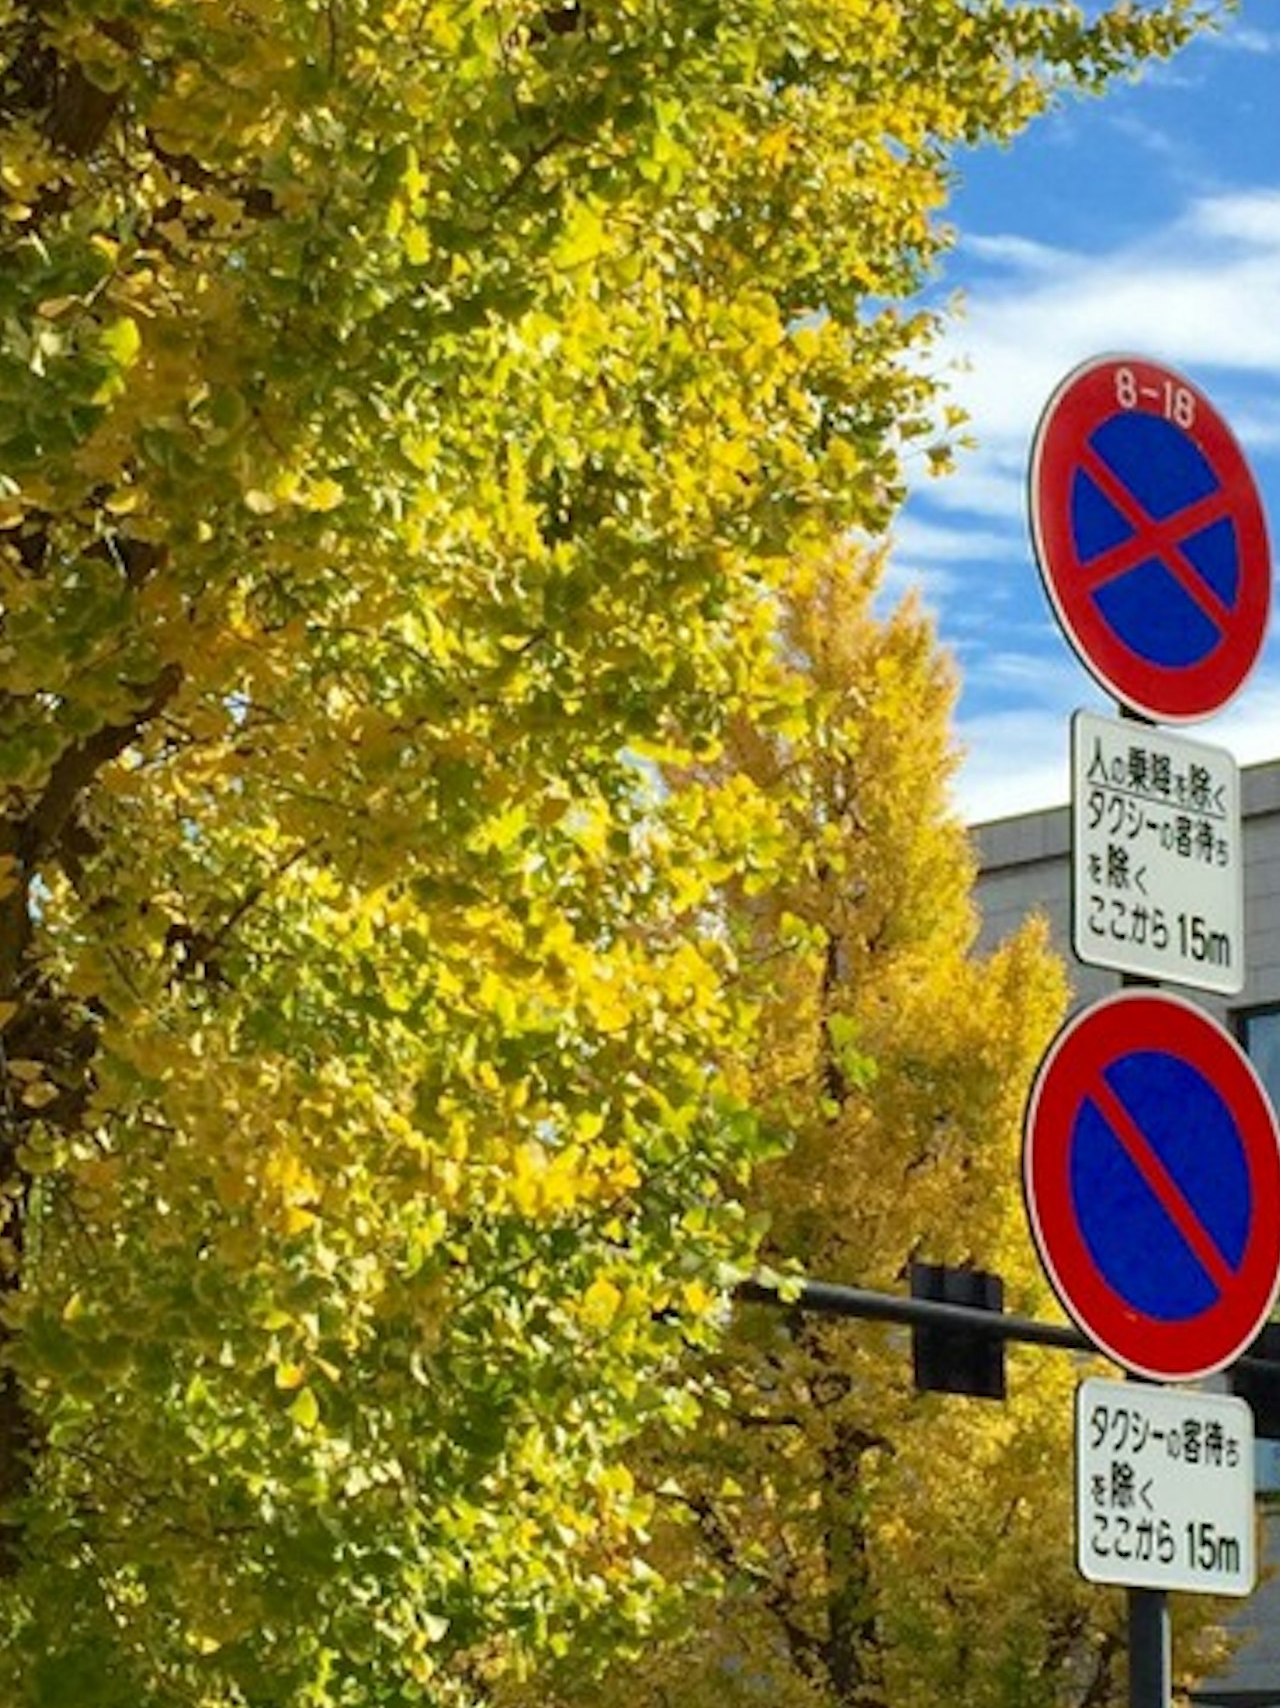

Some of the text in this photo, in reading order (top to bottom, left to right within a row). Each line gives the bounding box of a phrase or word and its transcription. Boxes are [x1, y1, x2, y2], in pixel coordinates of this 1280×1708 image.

[1114, 368, 1196, 430] 8-18
[1088, 792, 1229, 867] タクシーの客待ち
[1088, 844, 1148, 894] を除く
[1088, 895, 1231, 967] ここから 15m
[1091, 1405, 1239, 1467] タクシーの客待ち
[1091, 1461, 1153, 1510] を除く
[1091, 1515, 1239, 1573] ここから 15m
